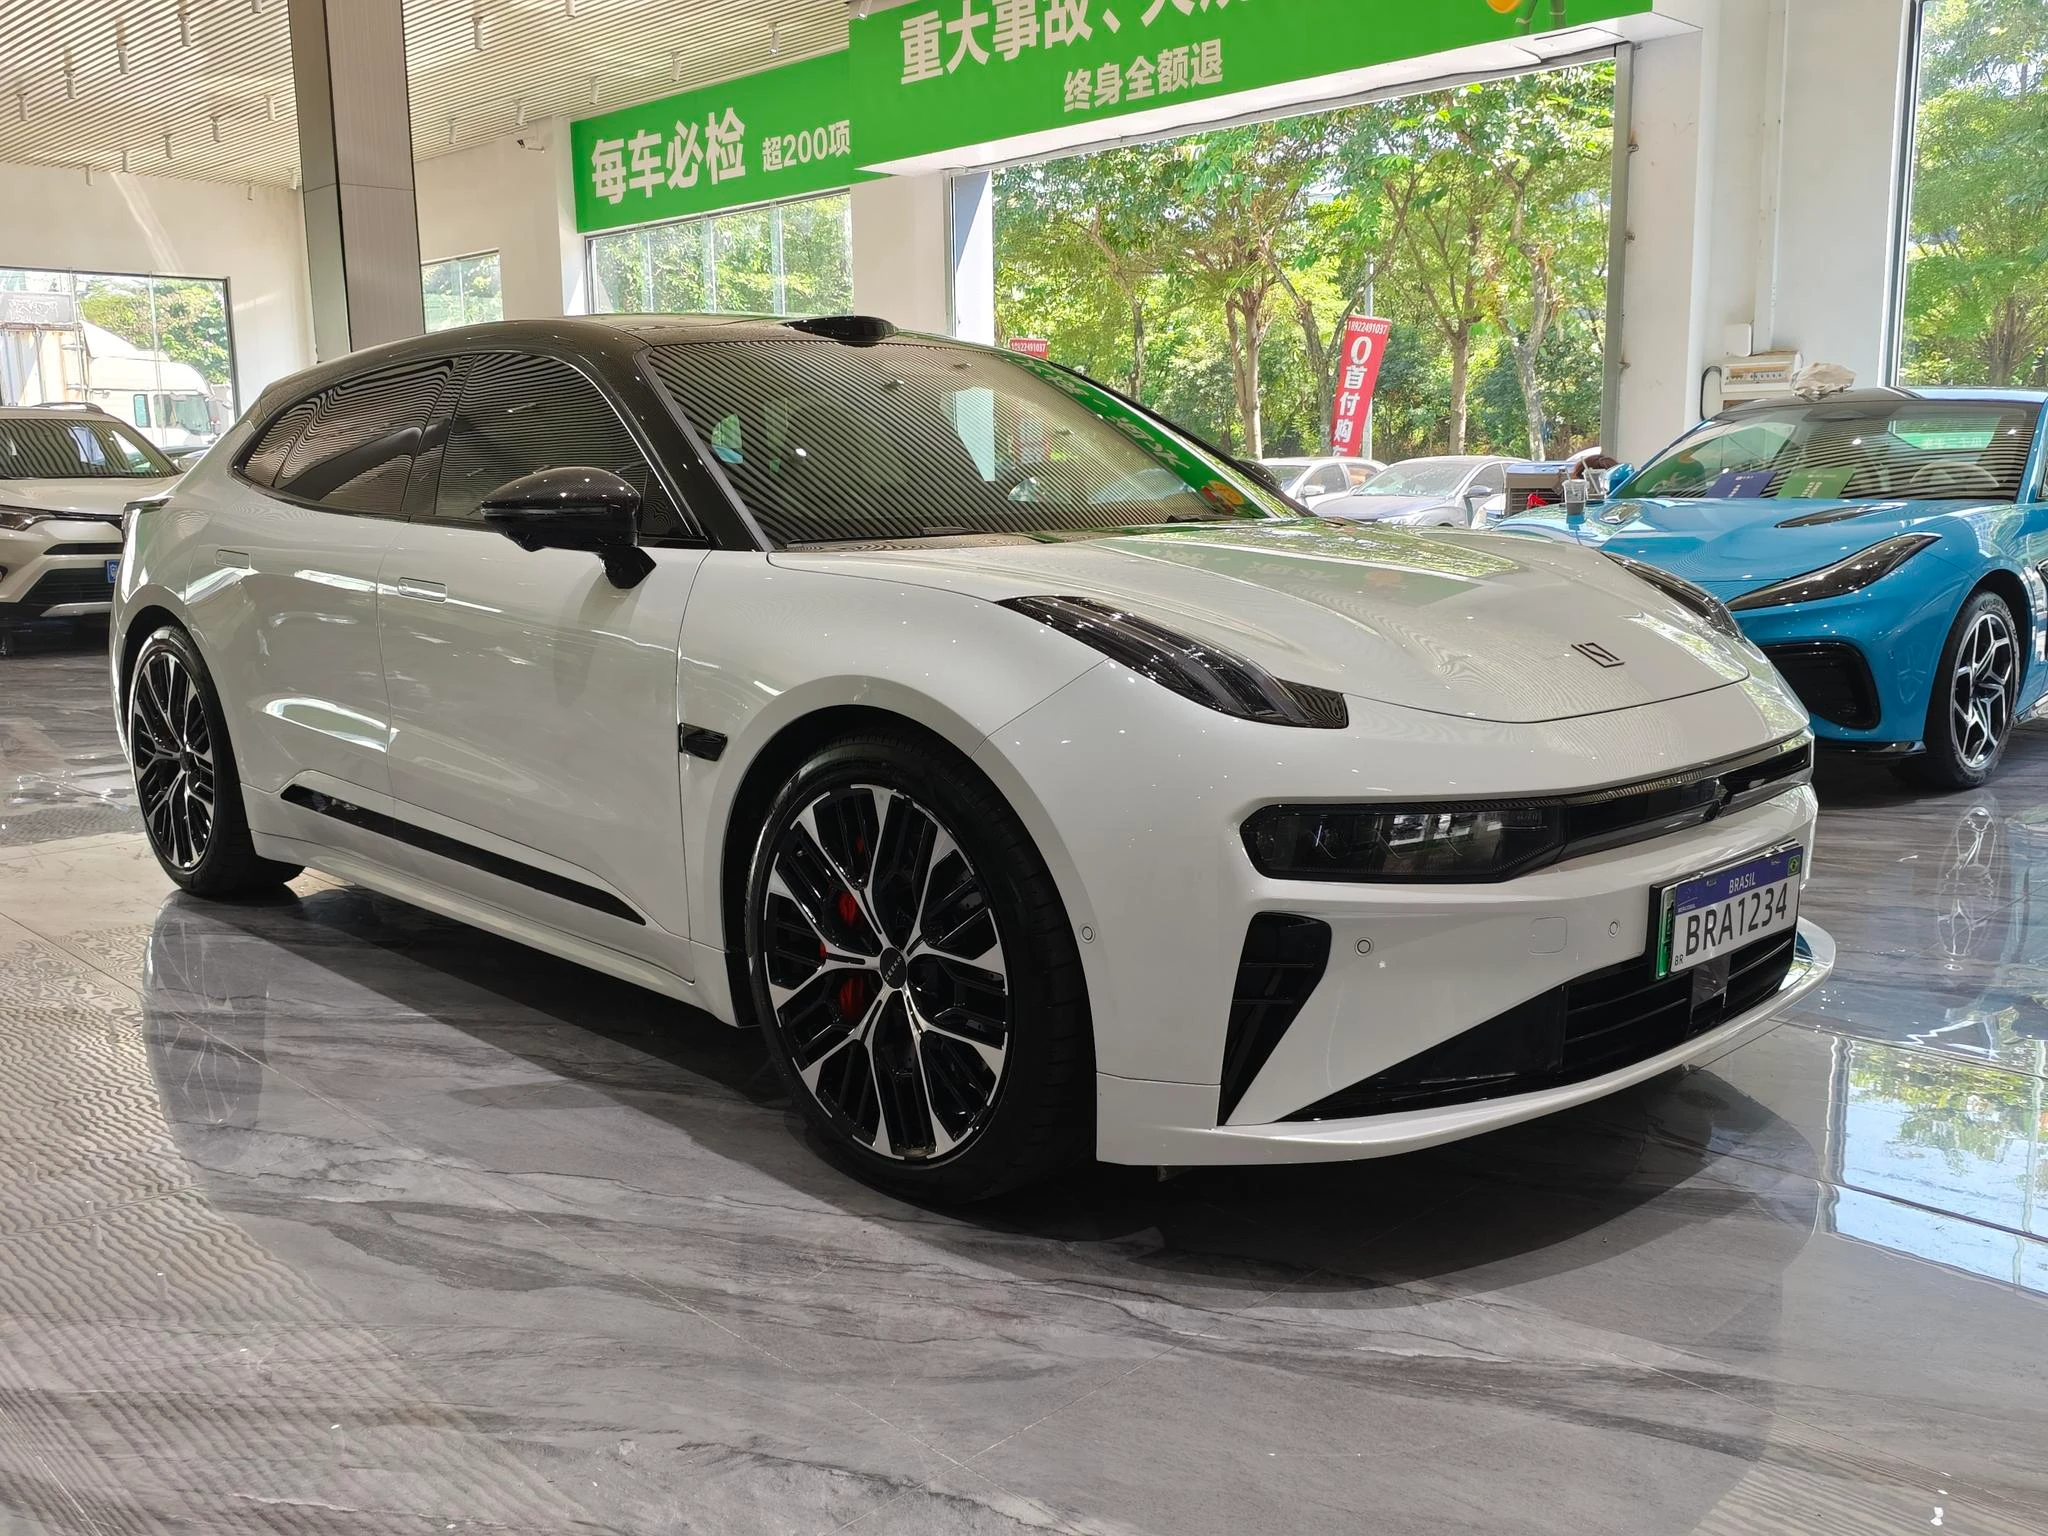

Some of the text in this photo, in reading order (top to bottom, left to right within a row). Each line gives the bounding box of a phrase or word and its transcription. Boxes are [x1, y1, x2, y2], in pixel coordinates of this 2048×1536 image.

[900, 0, 1249, 84] 重大事故、
[1064, 39, 1223, 112] 终身全额退
[591, 107, 851, 205] 每车必检 超200项
[1686, 883, 1787, 956] BRA1234
[1729, 872, 1756, 894] BRASIL
[1675, 954, 1683, 966] BR
